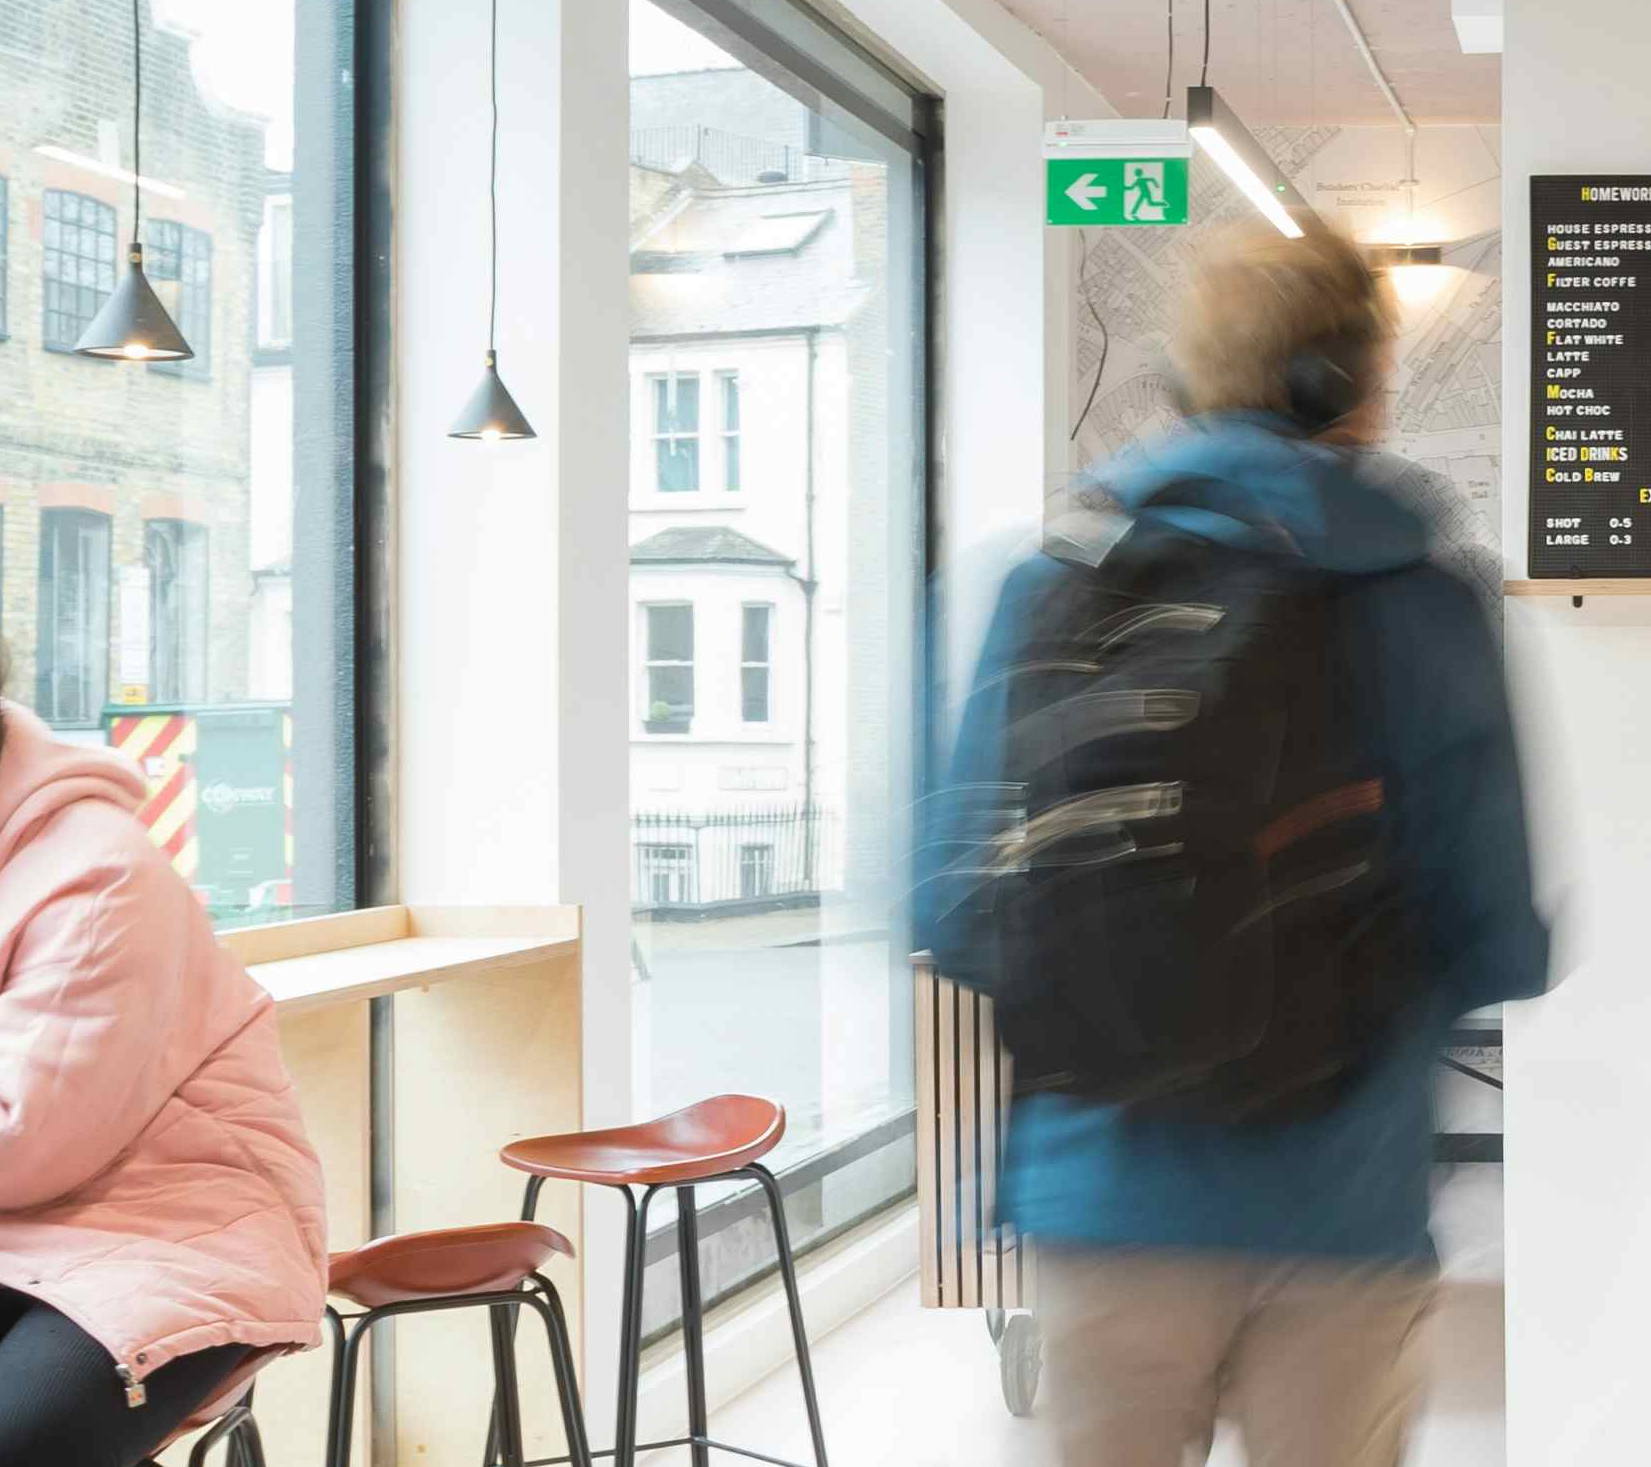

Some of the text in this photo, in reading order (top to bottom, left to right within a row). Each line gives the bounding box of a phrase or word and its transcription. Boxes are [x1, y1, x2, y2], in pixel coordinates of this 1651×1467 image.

[1547, 224, 1590, 234] HOUSE
[1548, 237, 1590, 250] GUEST
[1548, 257, 1620, 266] AMERICANO
[1547, 274, 1590, 287] FILTER
[1593, 277, 1636, 287] COFFE
[1547, 302, 1620, 312] MACCHIATO
[1547, 318, 1607, 328] CORTADO
[1547, 332, 1582, 345] FLAT
[1584, 335, 1623, 345] WHITE
[1547, 351, 1589, 361] LATTE
[1547, 368, 1581, 378] CAPP
[1547, 385, 1594, 399] MOCHA
[1547, 405, 1573, 416] HOT
[1576, 405, 1611, 416] CHOC
[1546, 427, 1577, 440] CHAI
[1581, 430, 1623, 440] LATTE
[1546, 447, 1577, 461] ICED
[1580, 447, 1628, 461] DRINKS
[1546, 468, 1620, 482] COLD BREW
[1547, 518, 1581, 528] SHOT
[1547, 535, 1589, 545] LARGE
